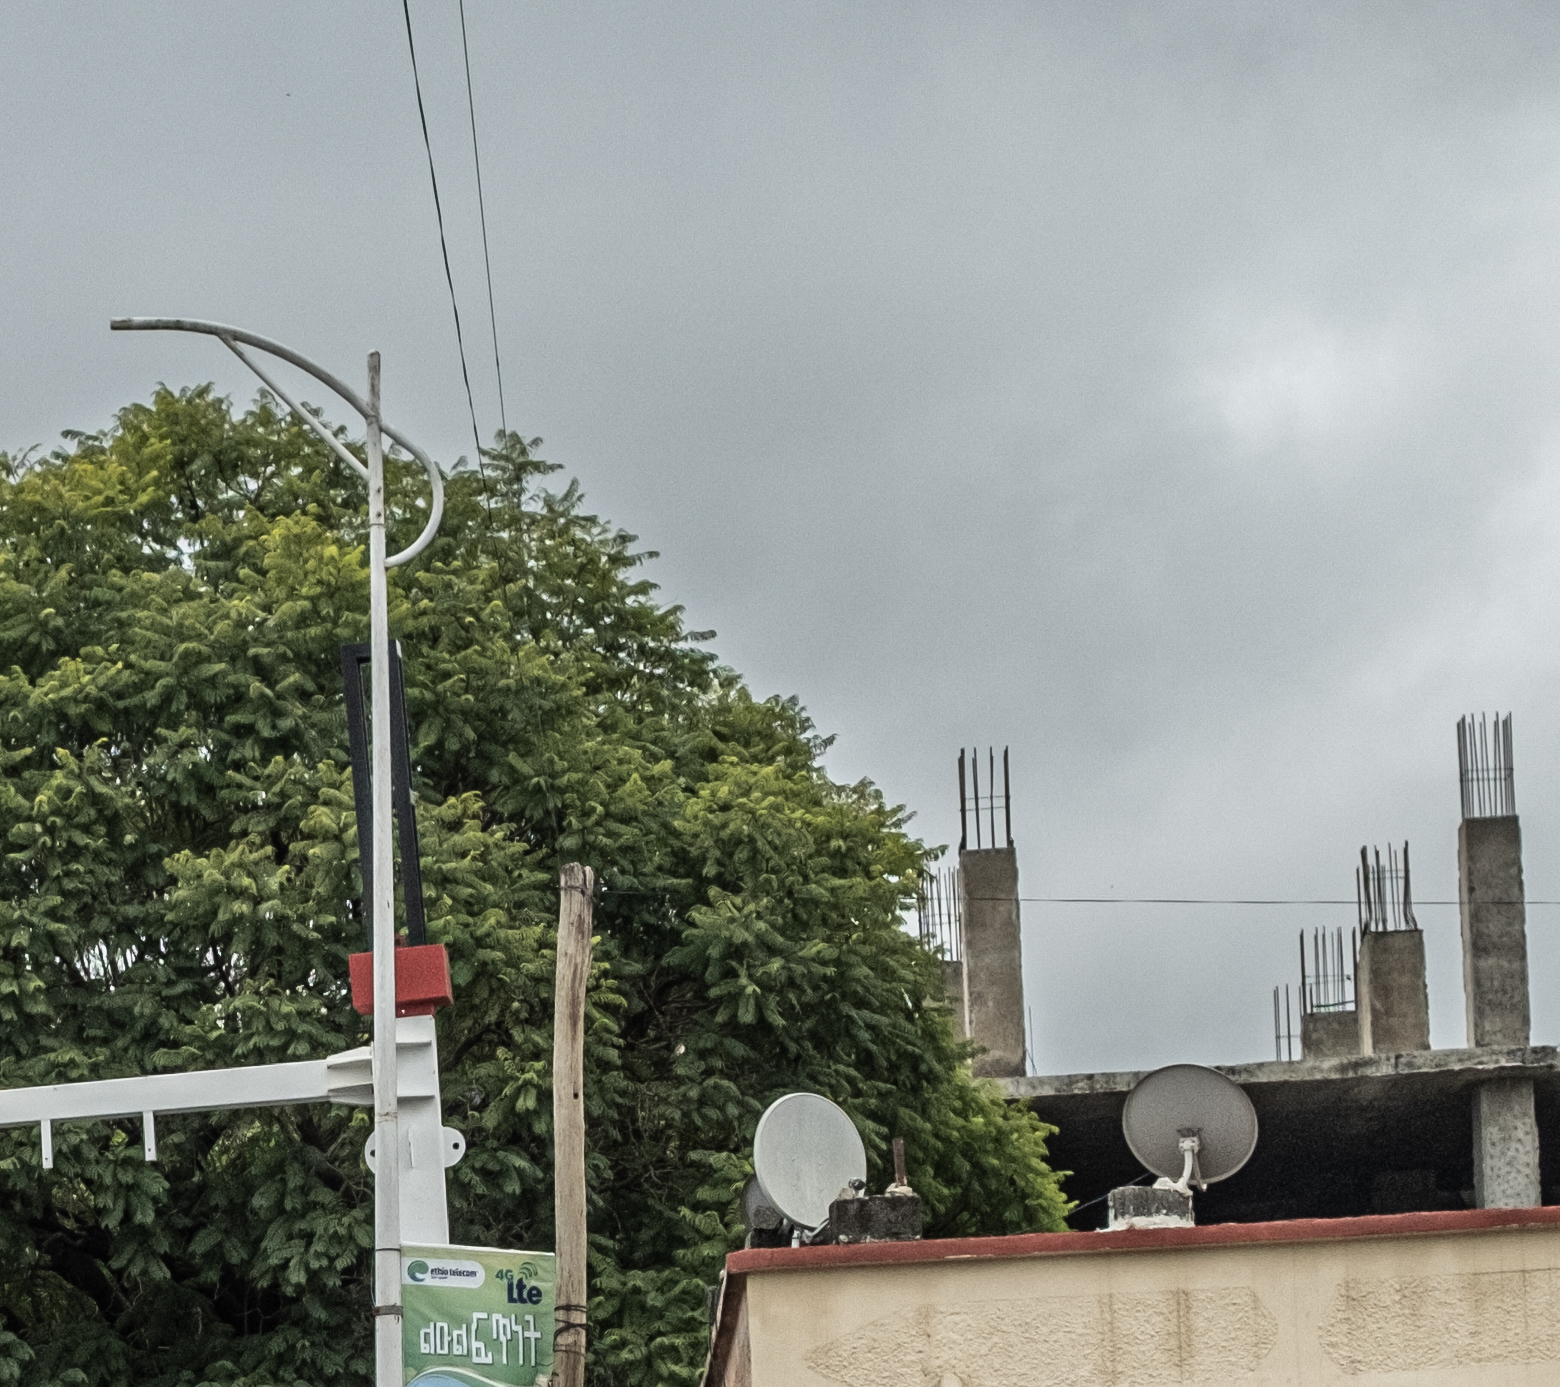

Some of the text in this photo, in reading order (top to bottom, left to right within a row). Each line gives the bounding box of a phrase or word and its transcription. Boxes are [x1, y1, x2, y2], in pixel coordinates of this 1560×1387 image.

[430, 1266, 478, 1278] ethio telecom
[495, 1269, 515, 1282] 4G
